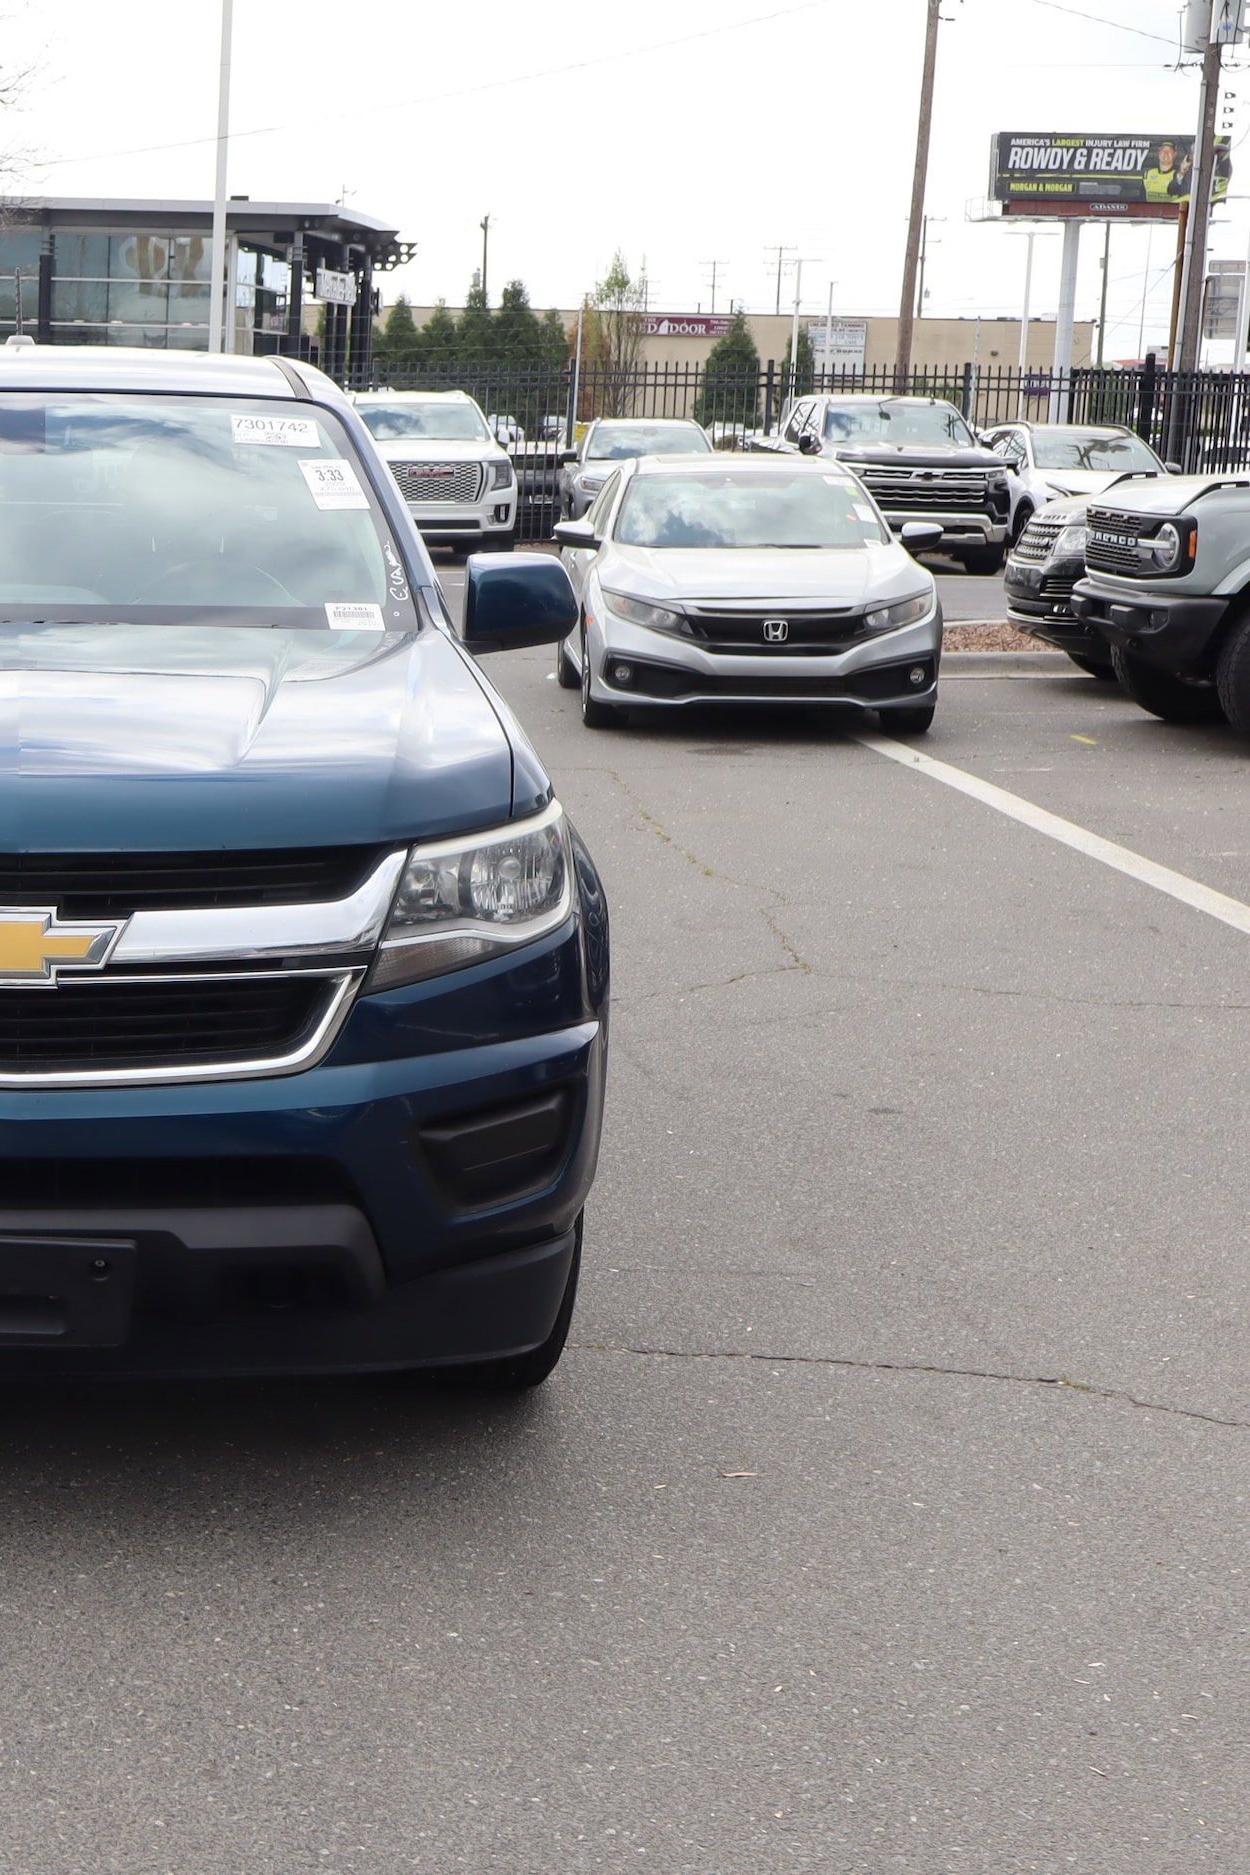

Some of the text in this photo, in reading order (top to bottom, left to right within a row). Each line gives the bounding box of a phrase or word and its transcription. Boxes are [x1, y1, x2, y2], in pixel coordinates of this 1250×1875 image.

[1052, 139, 1084, 147] LARGEST
[1085, 139, 1113, 148] INJURY
[1114, 140, 1130, 148] LAW
[1131, 140, 1150, 149] FIRM
[1008, 147, 1150, 171] ROWDY & READY
[1010, 182, 1038, 193] MORGAN
[1045, 183, 1073, 193] MORGAN
[670, 322, 707, 334] DOOR
[233, 417, 309, 434] 7301742
[315, 468, 344, 482] 3:33
